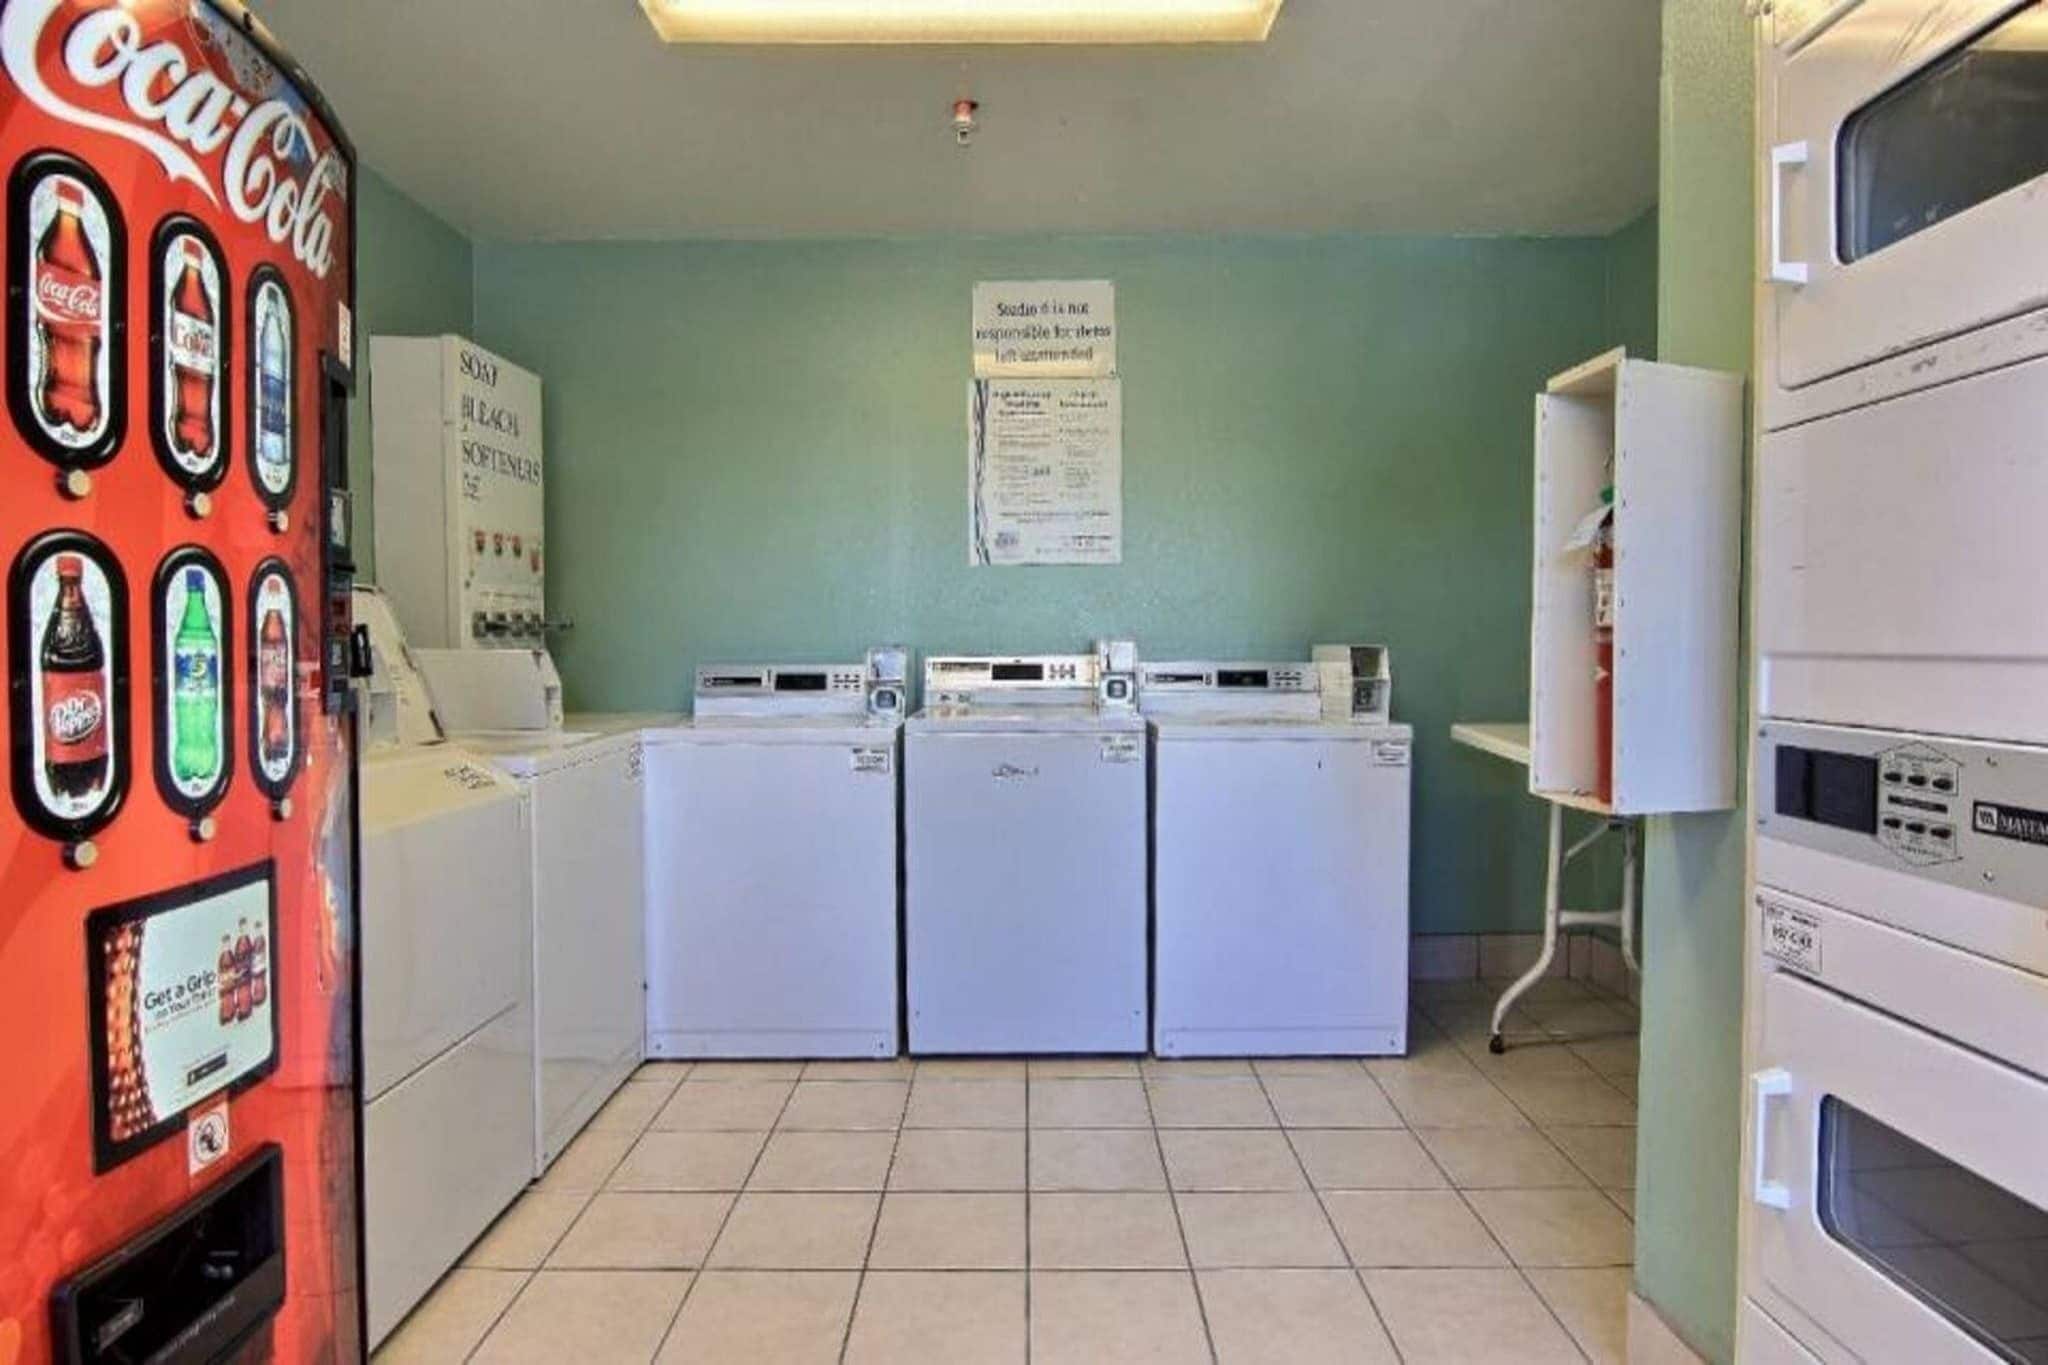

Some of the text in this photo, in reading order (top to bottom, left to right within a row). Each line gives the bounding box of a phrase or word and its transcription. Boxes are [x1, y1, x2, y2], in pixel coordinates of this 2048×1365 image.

[0, 0, 337, 279] Coca-Cola
[39, 272, 99, 318] Coca-Cola
[997, 301, 1038, 317] Studio
[1068, 302, 1090, 315] not
[976, 325, 1050, 343] responsible
[1055, 325, 1074, 339] for
[1021, 346, 1094, 362] unattended
[462, 394, 520, 437] BLEACH
[462, 440, 541, 487] SOFTENERS
[2000, 812, 2048, 839] MAYTA
[144, 988, 172, 1010] Get
[175, 984, 185, 999] a
[187, 969, 216, 993] Grip
